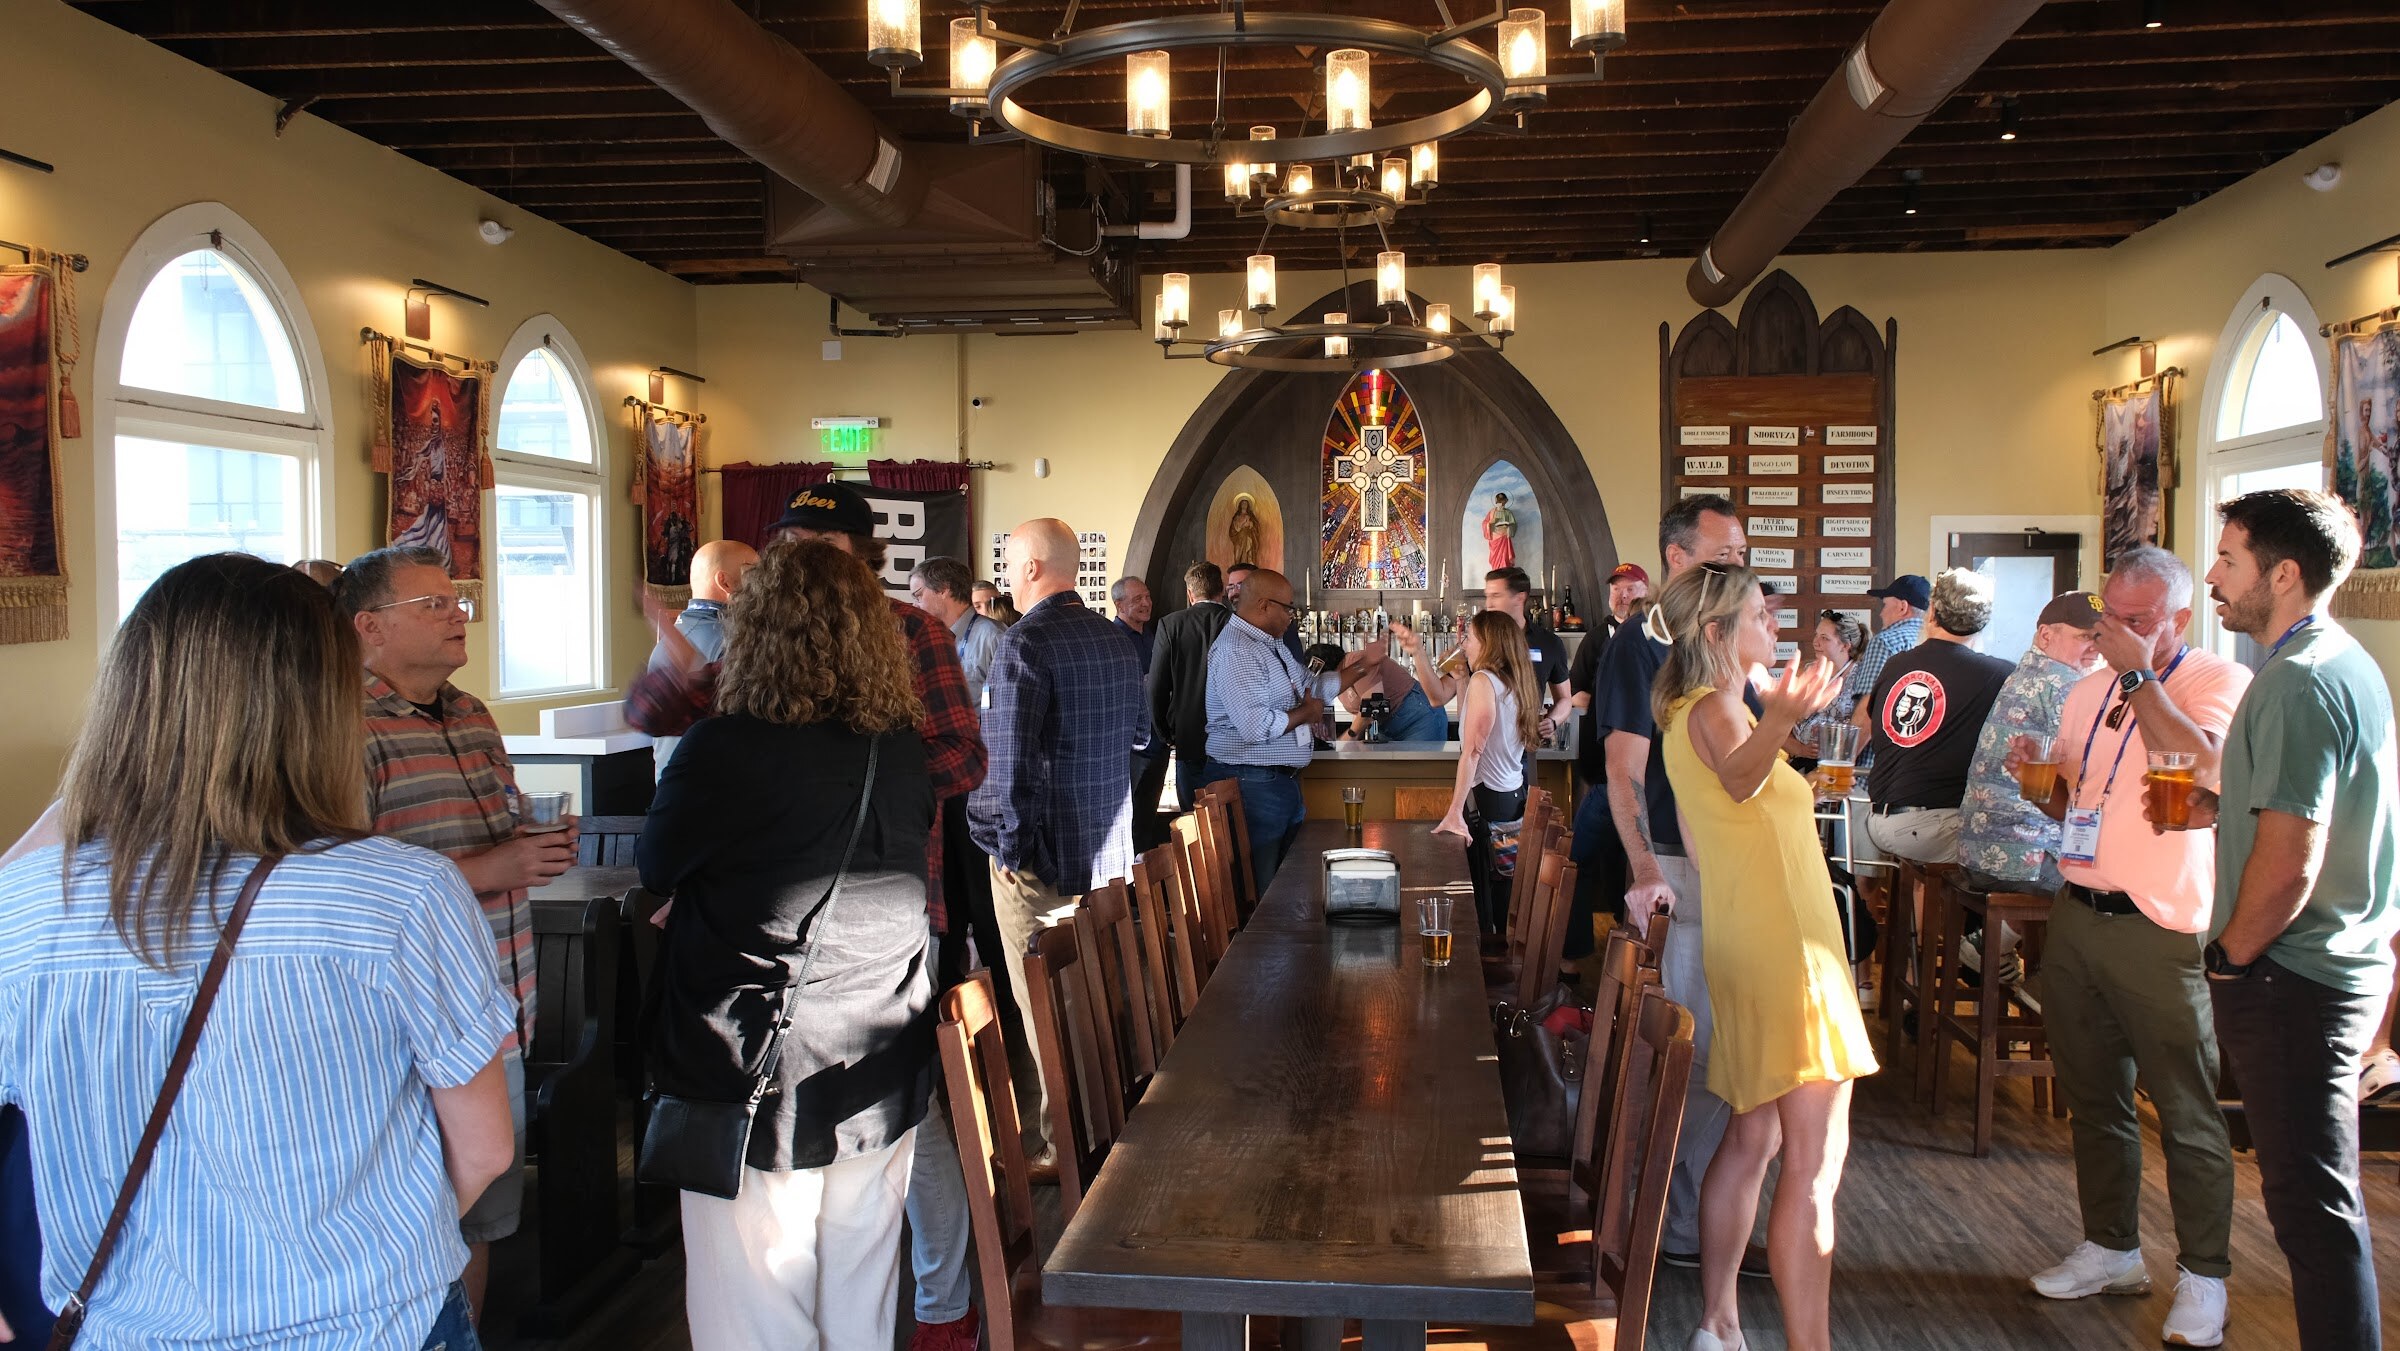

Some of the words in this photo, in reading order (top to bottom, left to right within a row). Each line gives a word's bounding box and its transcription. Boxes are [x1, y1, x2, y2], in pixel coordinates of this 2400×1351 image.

[831, 426, 861, 452] EXIT
[1753, 431, 1796, 439] SHORVEZA
[1830, 461, 1870, 469] DEVOTION
[790, 490, 836, 510] Beer
[1752, 524, 1795, 532] EVERYTHING
[2087, 595, 2104, 613] SD
[1900, 672, 1943, 699] TORONADO
